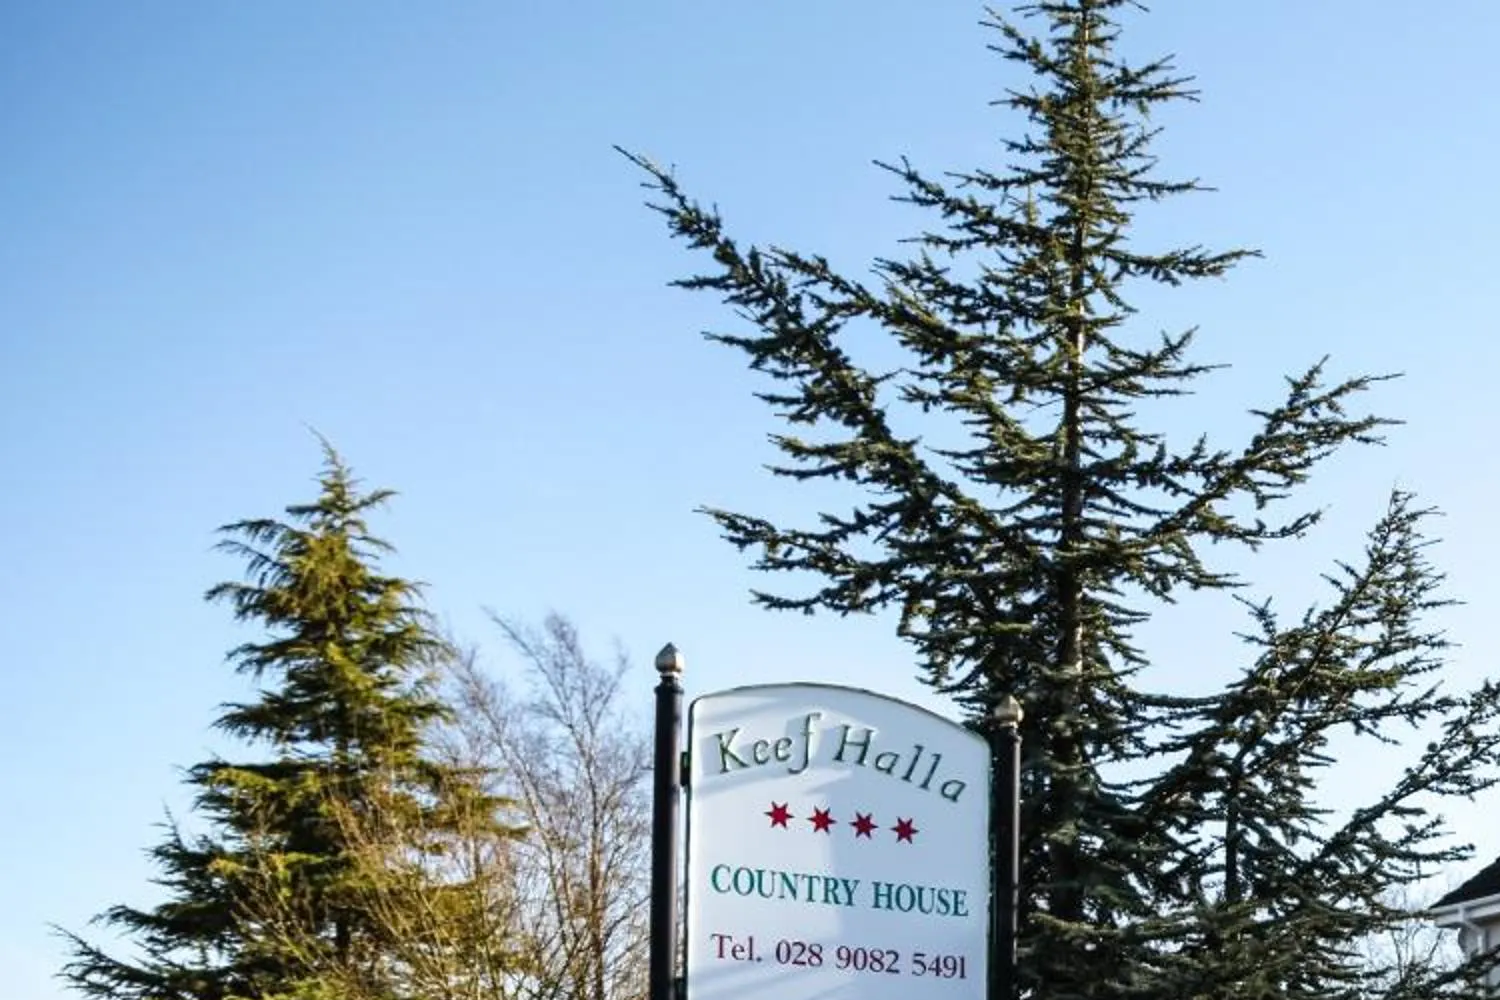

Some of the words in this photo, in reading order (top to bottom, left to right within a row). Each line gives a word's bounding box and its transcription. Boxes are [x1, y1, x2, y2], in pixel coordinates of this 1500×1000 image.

[714, 711, 823, 775] Keef
[832, 723, 968, 803] Halla
[711, 863, 860, 907] COUNTRY
[871, 880, 970, 917] HOUSE
[711, 933, 763, 962] Tel.
[775, 940, 824, 968] 028
[835, 945, 901, 975] 9082
[911, 953, 967, 979] 5491
